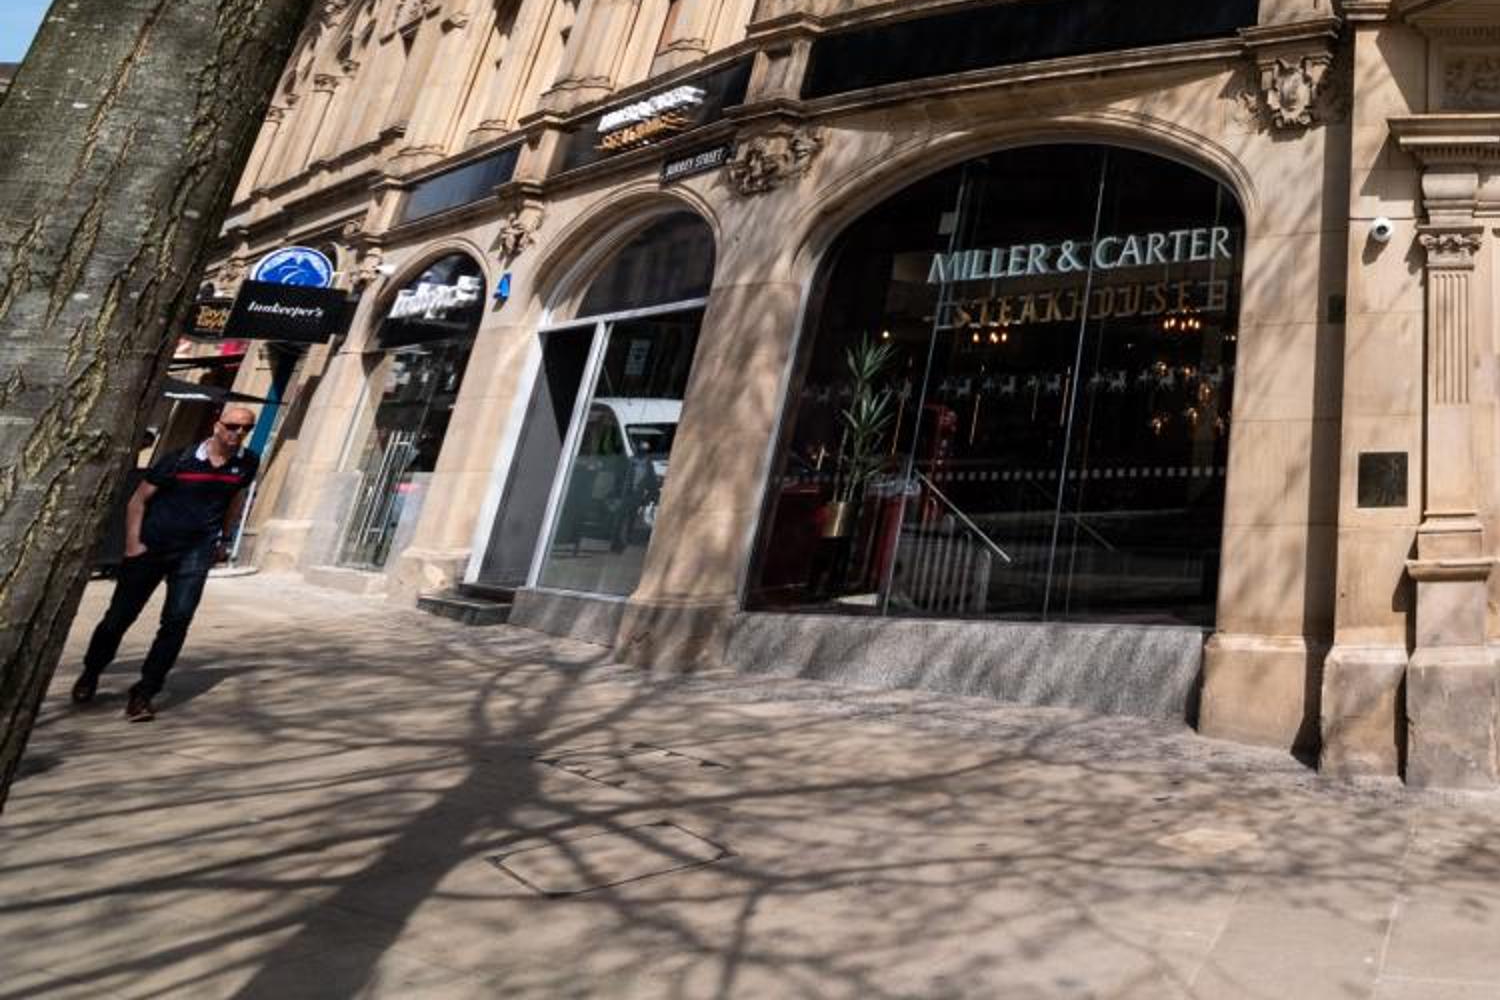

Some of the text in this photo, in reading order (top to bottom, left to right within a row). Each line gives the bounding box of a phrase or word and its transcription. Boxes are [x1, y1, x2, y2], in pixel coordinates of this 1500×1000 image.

[927, 226, 1232, 284] MILLER & CARTER
[954, 279, 1193, 327] STEAKHOUSE
